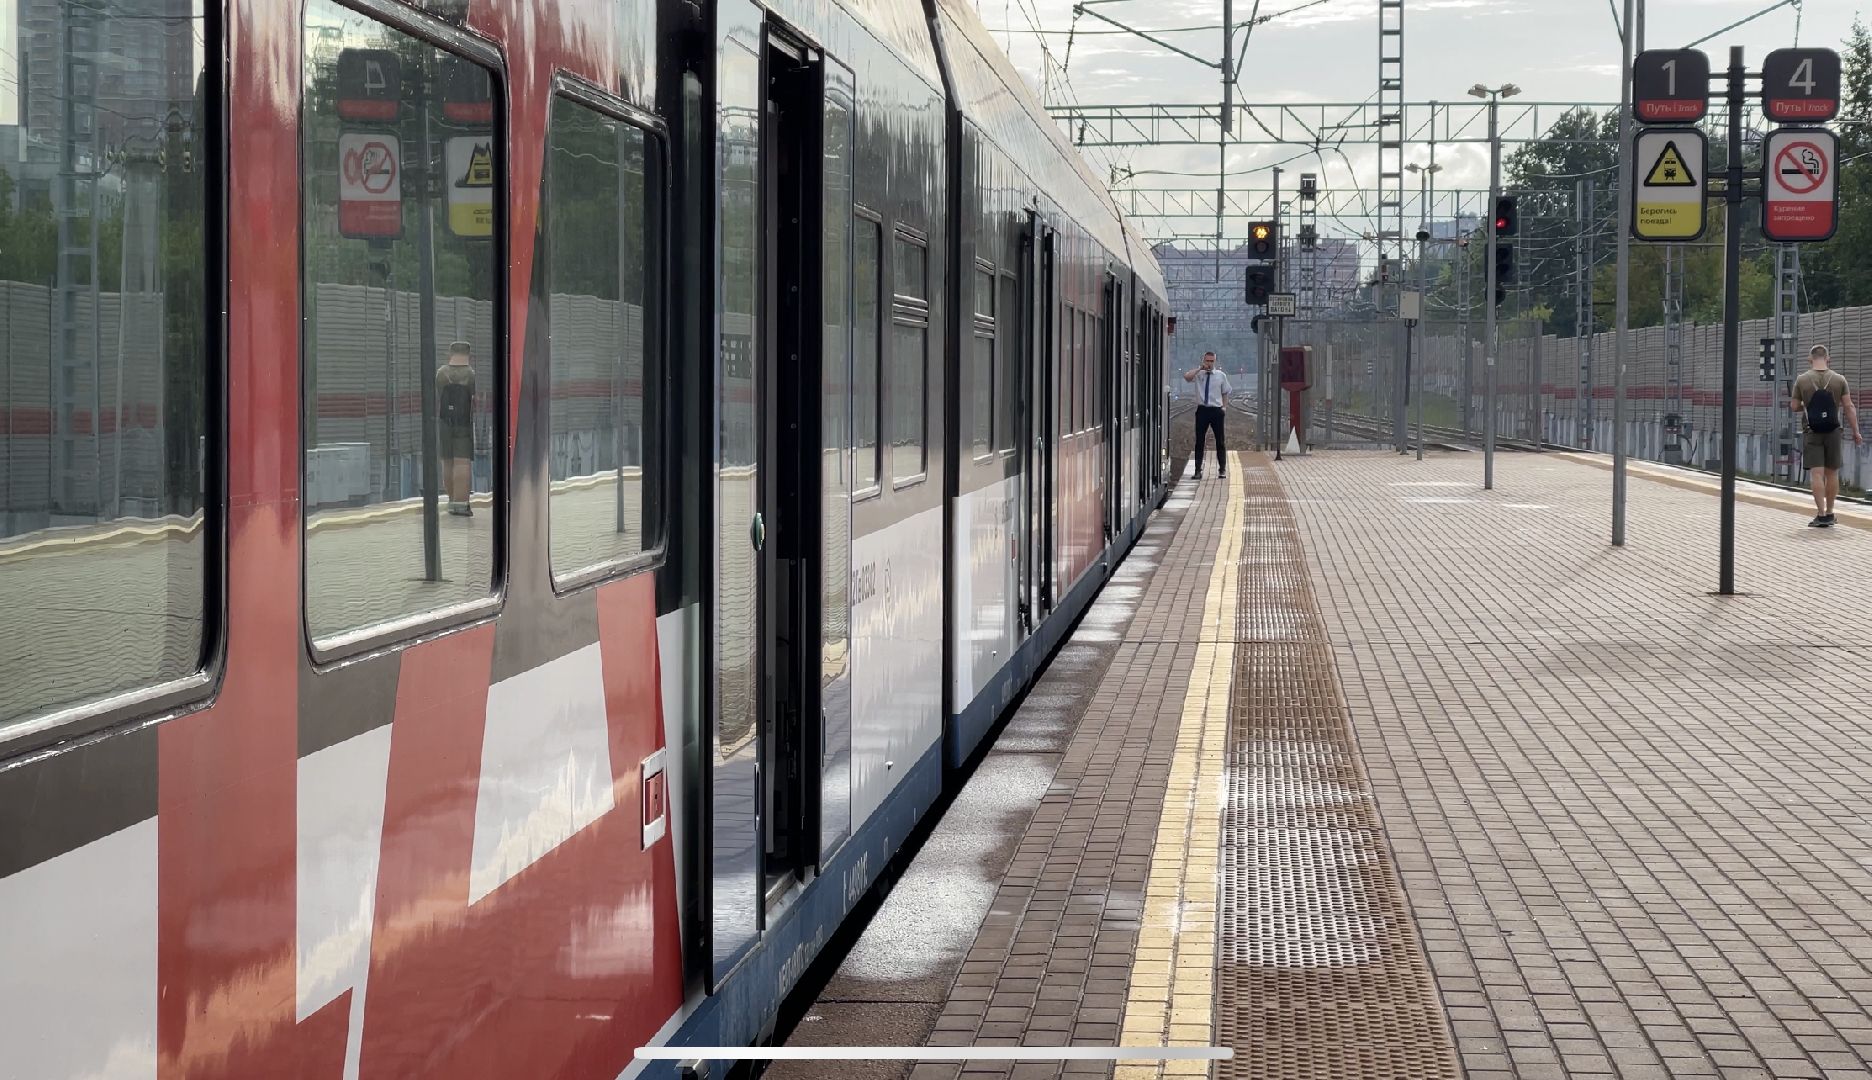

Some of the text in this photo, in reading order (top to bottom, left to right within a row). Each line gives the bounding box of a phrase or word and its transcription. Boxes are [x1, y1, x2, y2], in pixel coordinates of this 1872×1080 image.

[1661, 59, 1676, 96] 1
[1788, 58, 1817, 95] 4
[1646, 103, 1672, 115] Путь
[1776, 101, 1801, 113] Путь
